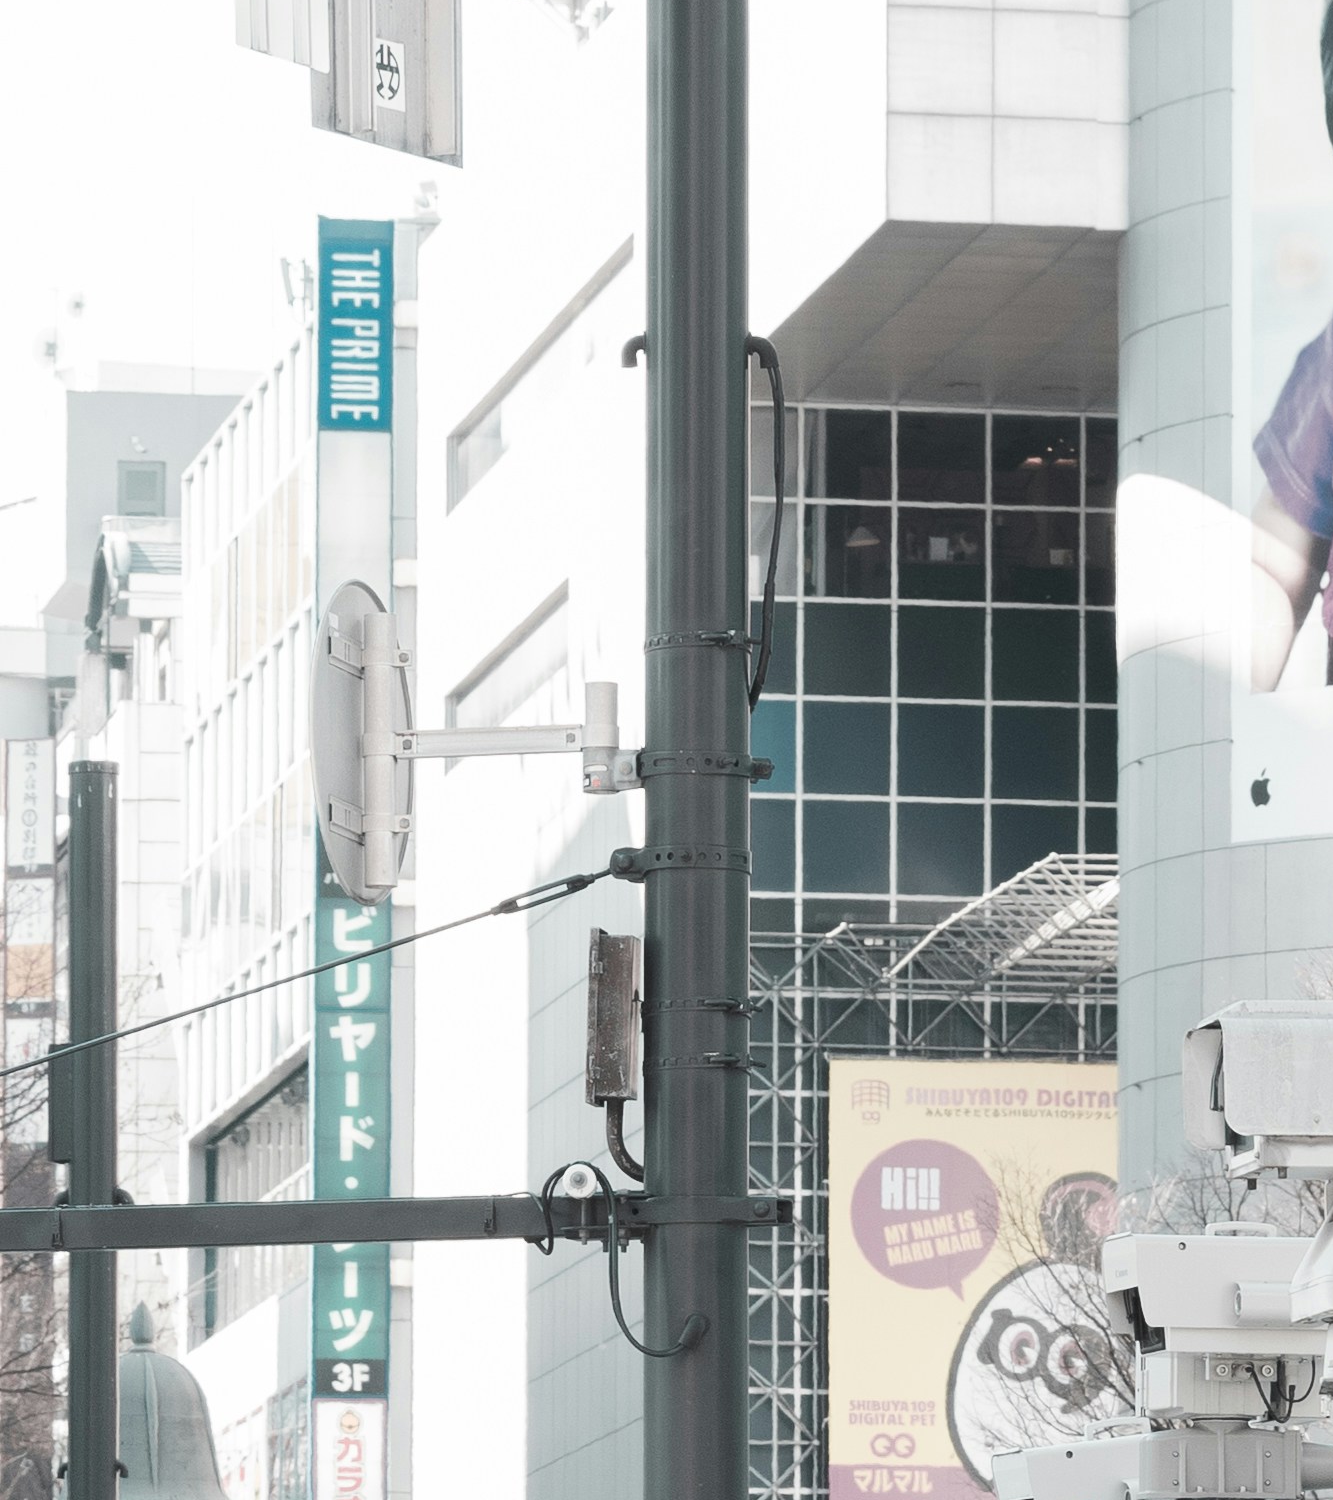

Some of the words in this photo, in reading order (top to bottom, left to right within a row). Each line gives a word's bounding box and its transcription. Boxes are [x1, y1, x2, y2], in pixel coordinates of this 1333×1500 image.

[331, 249, 381, 309] THE
[331, 318, 380, 421] PRIME
[327, 906, 377, 1352] ビリヤード・ーツ
[881, 1166, 940, 1211] Hi!!
[883, 1222, 909, 1247] MY
[910, 1214, 957, 1241] NAME
[958, 1209, 977, 1231] IS
[886, 1241, 936, 1267] MARU
[937, 1228, 985, 1254] MARU
[331, 1362, 371, 1393] 3F
[849, 1413, 905, 1425] DIGITAL
[910, 1413, 936, 1426] PET
[853, 1469, 933, 1493] マルマル
